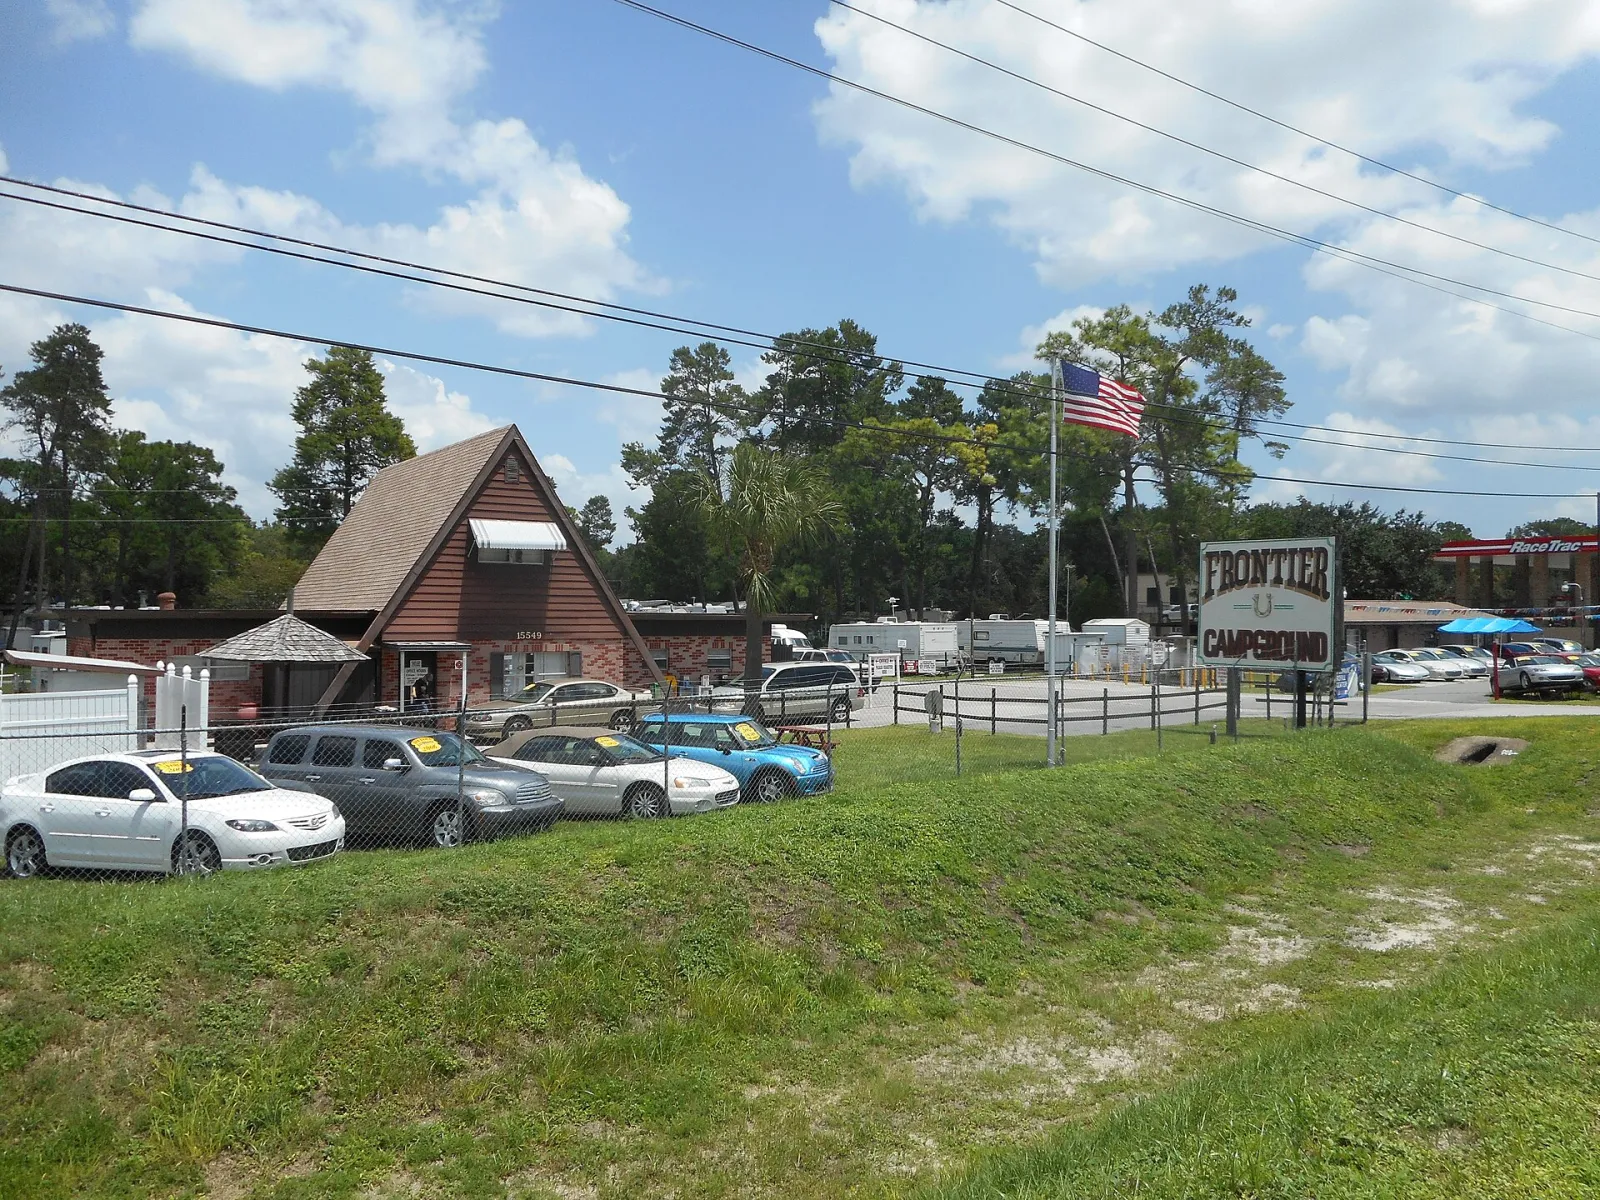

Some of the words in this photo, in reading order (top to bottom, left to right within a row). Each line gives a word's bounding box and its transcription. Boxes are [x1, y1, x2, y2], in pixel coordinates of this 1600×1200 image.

[1509, 540, 1581, 553] RaceTrac
[1202, 547, 1331, 604] FRONTIER
[516, 631, 542, 640] 15549
[1203, 628, 1328, 663] CAMPGROUND
